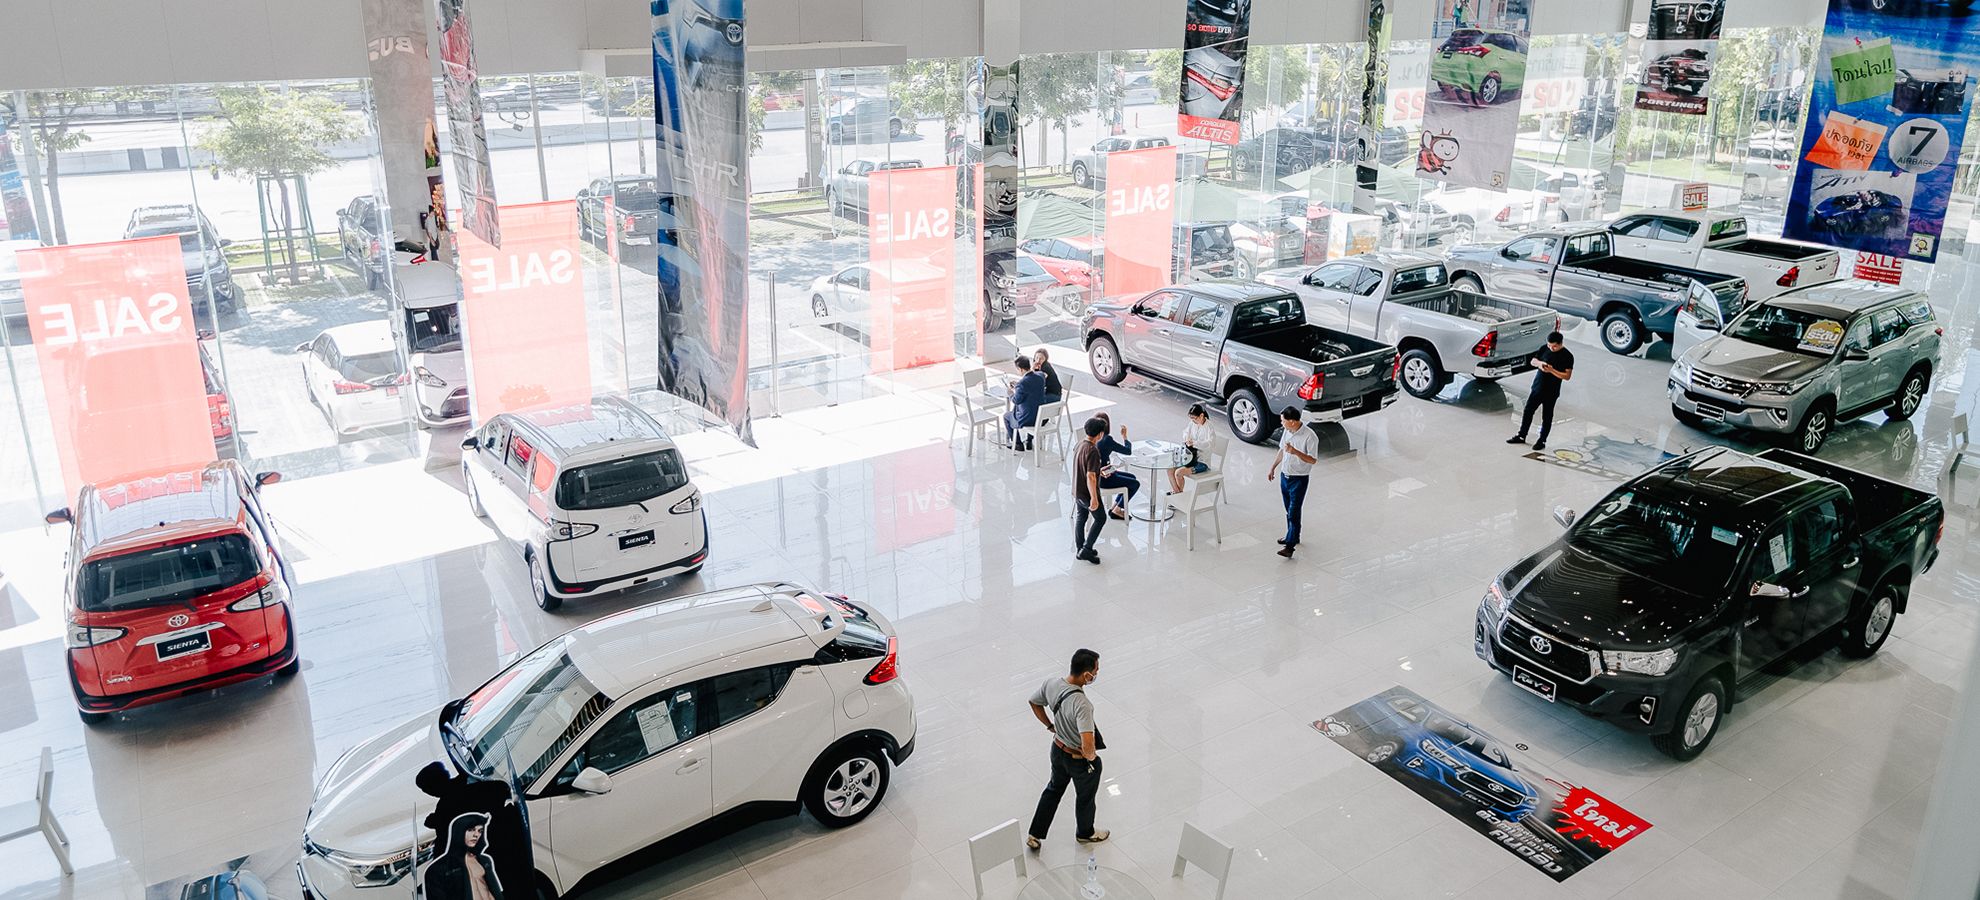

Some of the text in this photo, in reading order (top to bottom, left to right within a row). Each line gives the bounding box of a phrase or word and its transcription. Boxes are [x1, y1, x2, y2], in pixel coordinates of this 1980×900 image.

[1833, 57, 1893, 84] โดนใจ!!
[1638, 97, 1704, 110] FORTUNER
[1187, 125, 1233, 141] ALTIS
[1909, 126, 1938, 157] 7
[1896, 156, 1935, 168] AIRBAGS
[1813, 175, 1867, 191] ATIV
[1683, 193, 1708, 206] SALE
[1856, 250, 1902, 269] SALE
[625, 535, 649, 545] SIENTA
[166, 638, 200, 652] SIENTA
[1573, 797, 1637, 839] ใหม่
